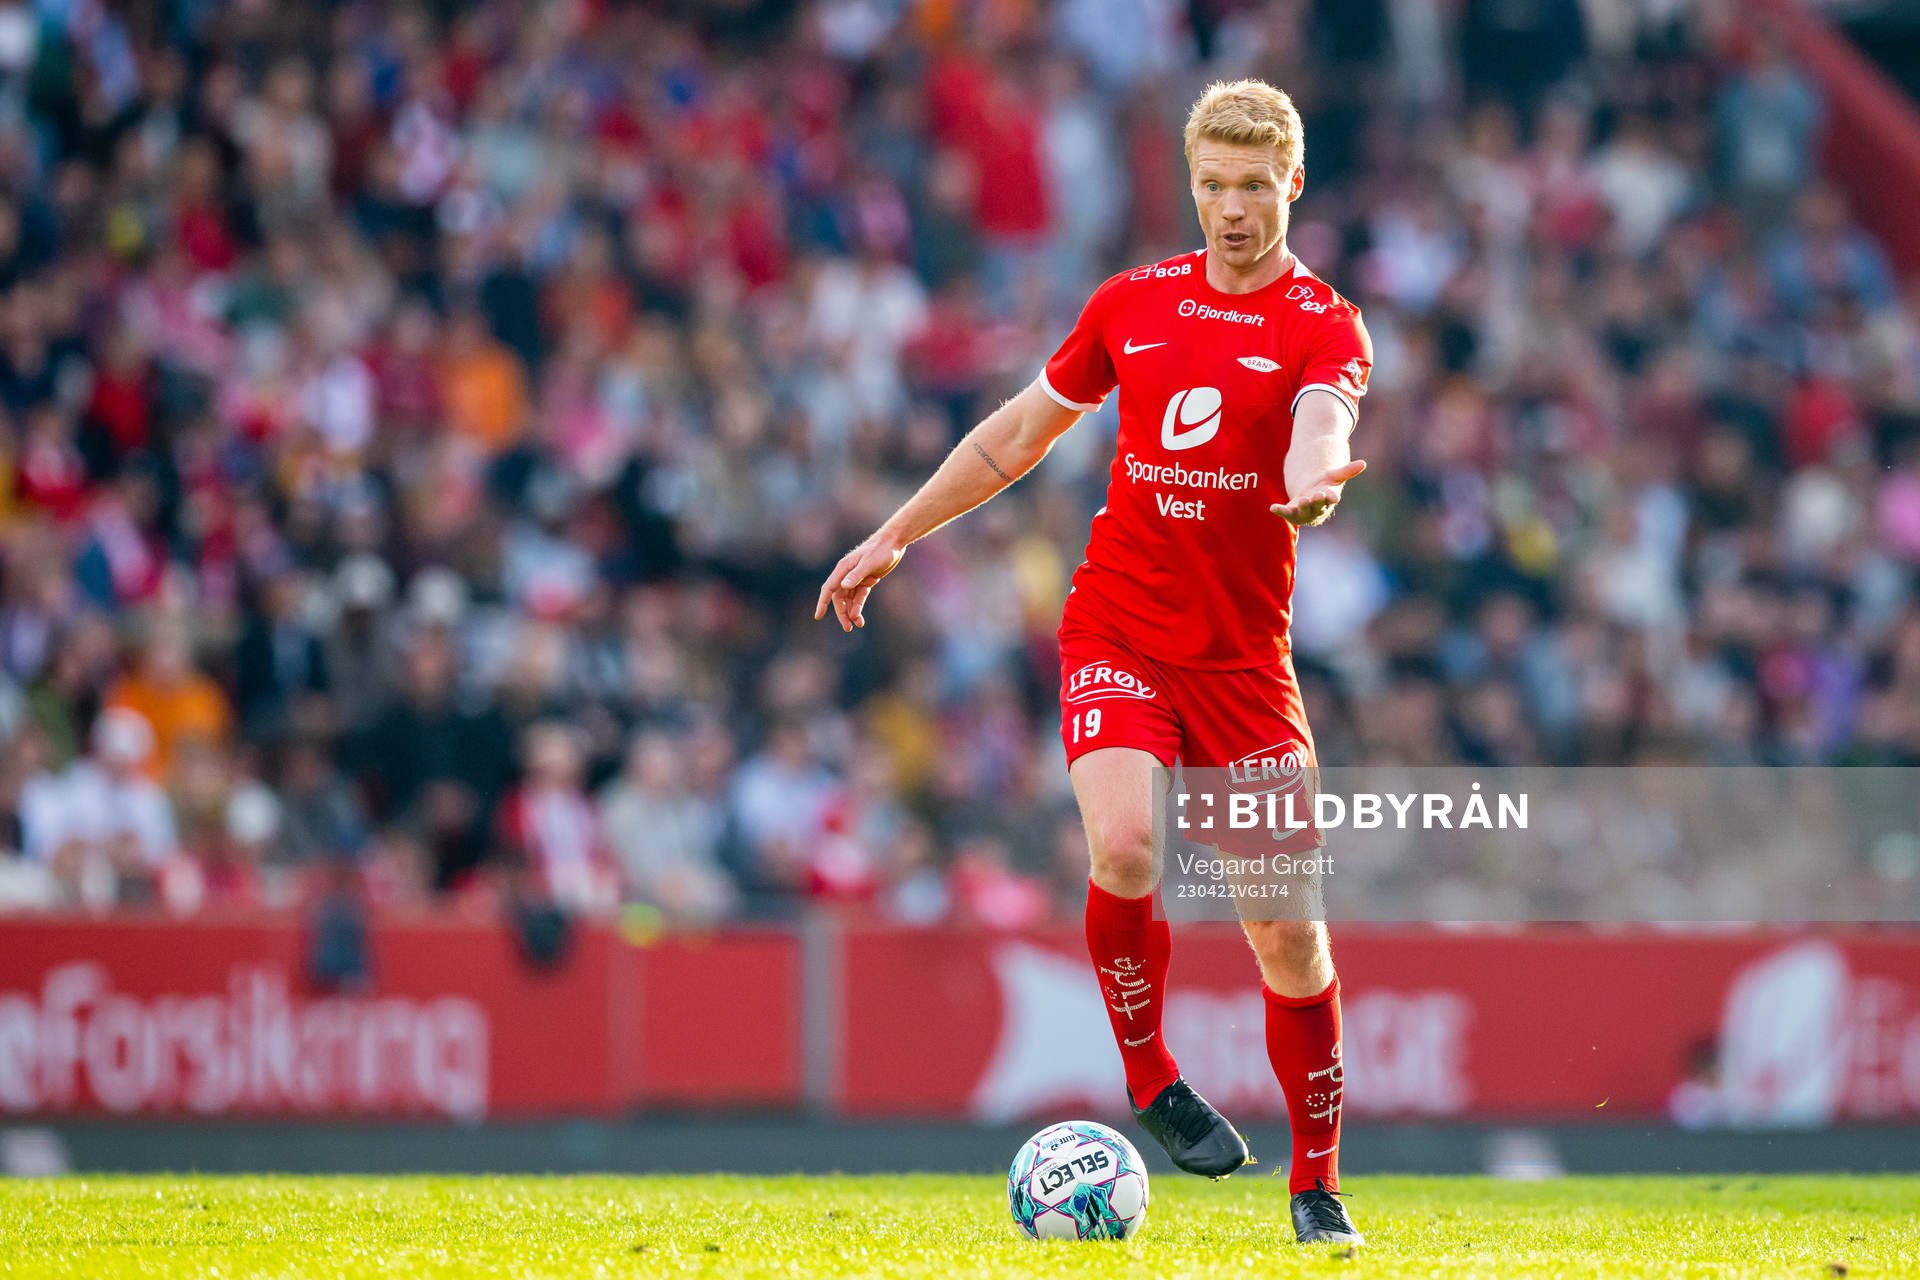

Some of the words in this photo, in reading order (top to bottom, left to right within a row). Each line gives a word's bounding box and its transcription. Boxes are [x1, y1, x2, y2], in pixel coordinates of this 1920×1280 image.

[1155, 264, 1192, 278] BOB
[1197, 305, 1265, 326] Fjordkraft
[1125, 453, 1258, 490] Sparebanken
[1155, 493, 1206, 521] Vest
[1070, 667, 1151, 696] LERØY
[1072, 708, 1102, 744] 19
[1228, 746, 1308, 784] LERØY
[1040, 1150, 1109, 1196] SELECT
